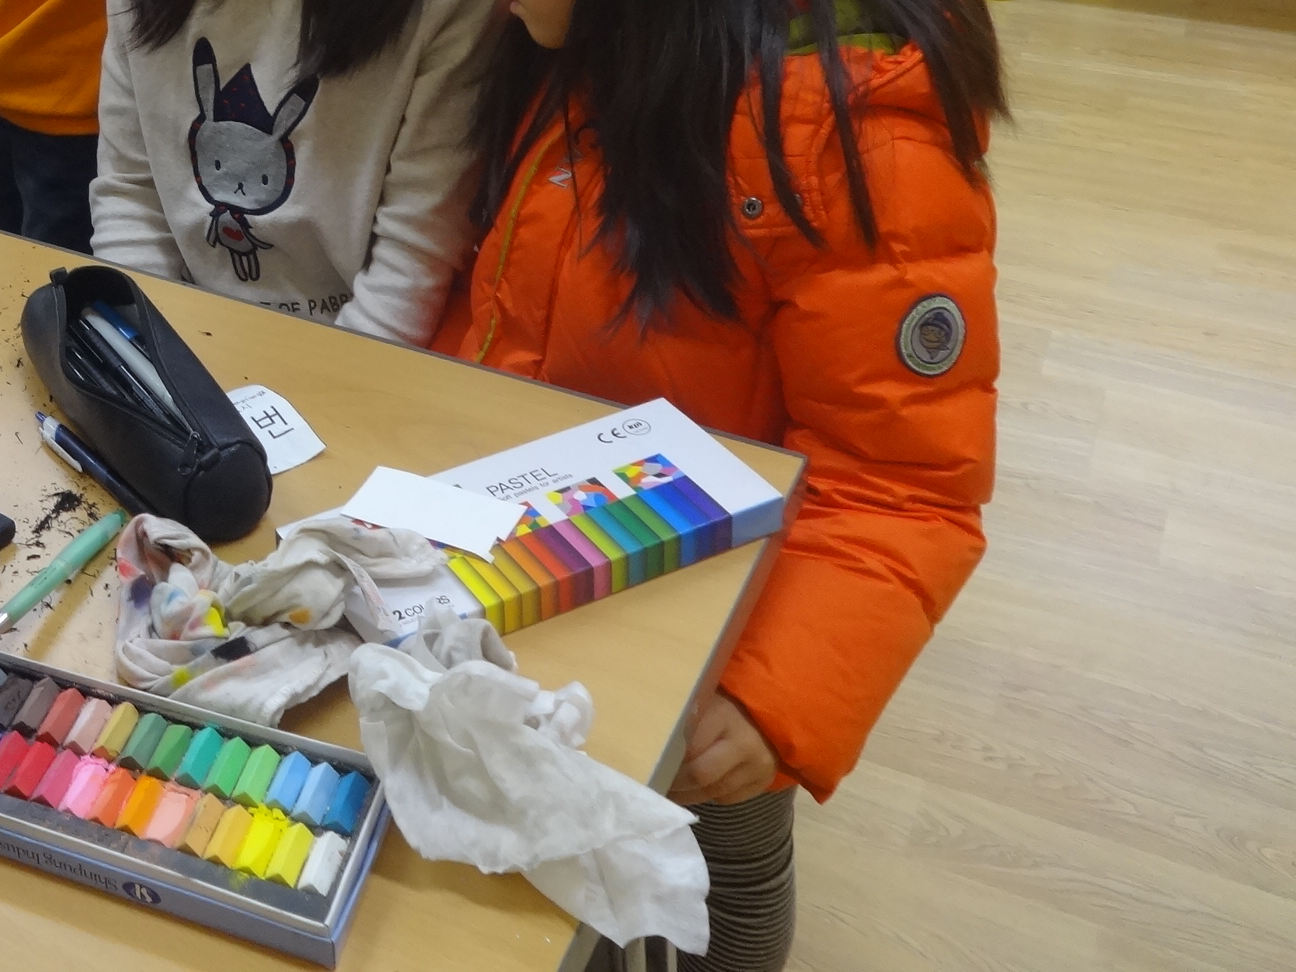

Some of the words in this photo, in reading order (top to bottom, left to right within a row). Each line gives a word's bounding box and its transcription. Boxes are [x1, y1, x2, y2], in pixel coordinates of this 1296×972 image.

[486, 467, 558, 497] PASTEL
[514, 484, 540, 498] pastels
[539, 480, 550, 489] for
[552, 473, 574, 484] artists
[42, 848, 119, 892] Shinpung
